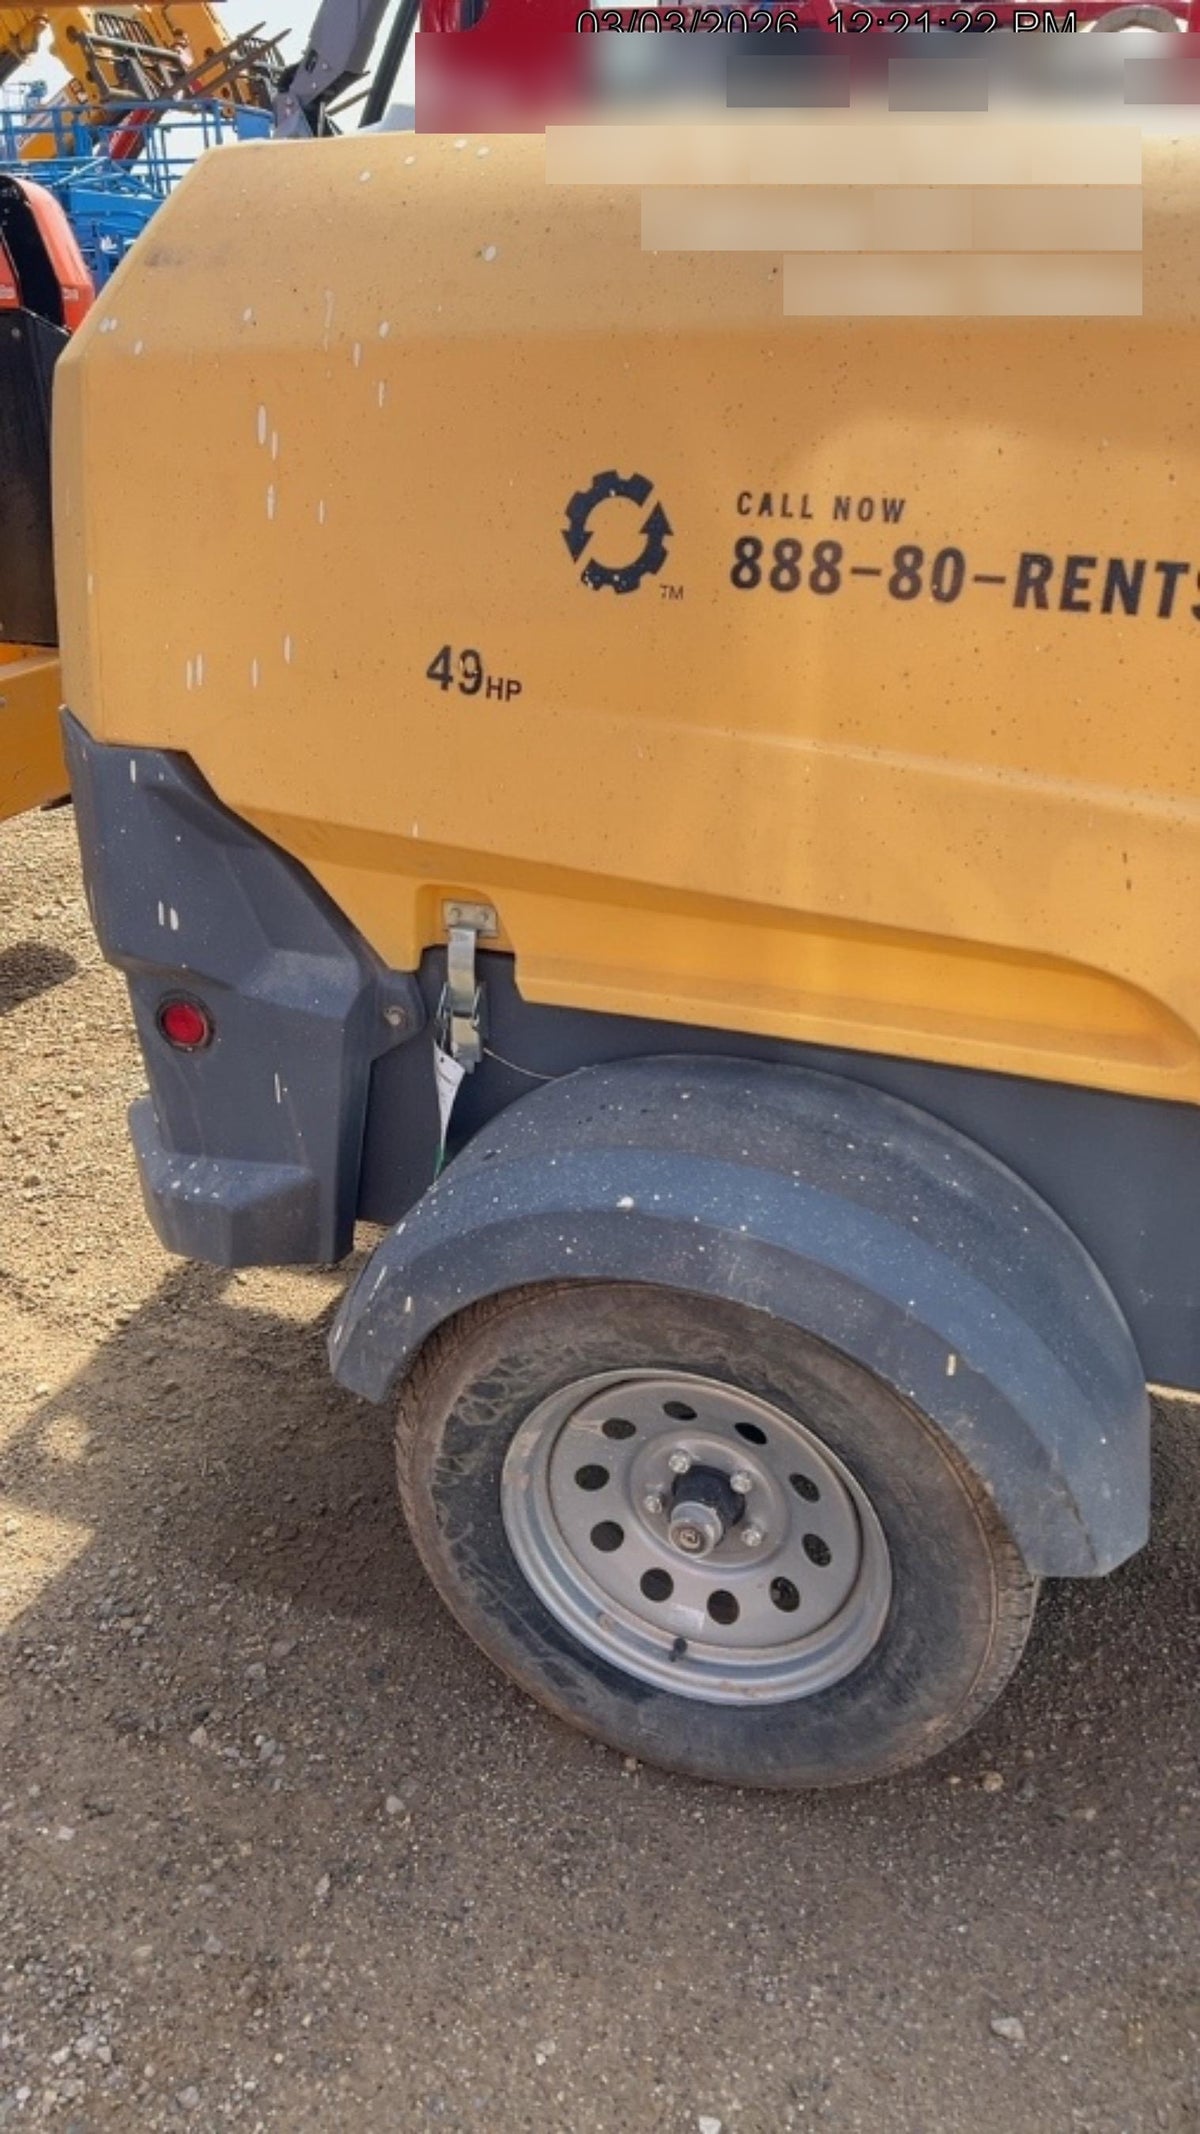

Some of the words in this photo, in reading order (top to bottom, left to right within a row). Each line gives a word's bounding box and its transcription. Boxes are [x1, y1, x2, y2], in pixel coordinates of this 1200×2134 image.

[736, 490, 813, 519] CALL
[833, 495, 906, 523] NOW
[659, 584, 684, 600] TM
